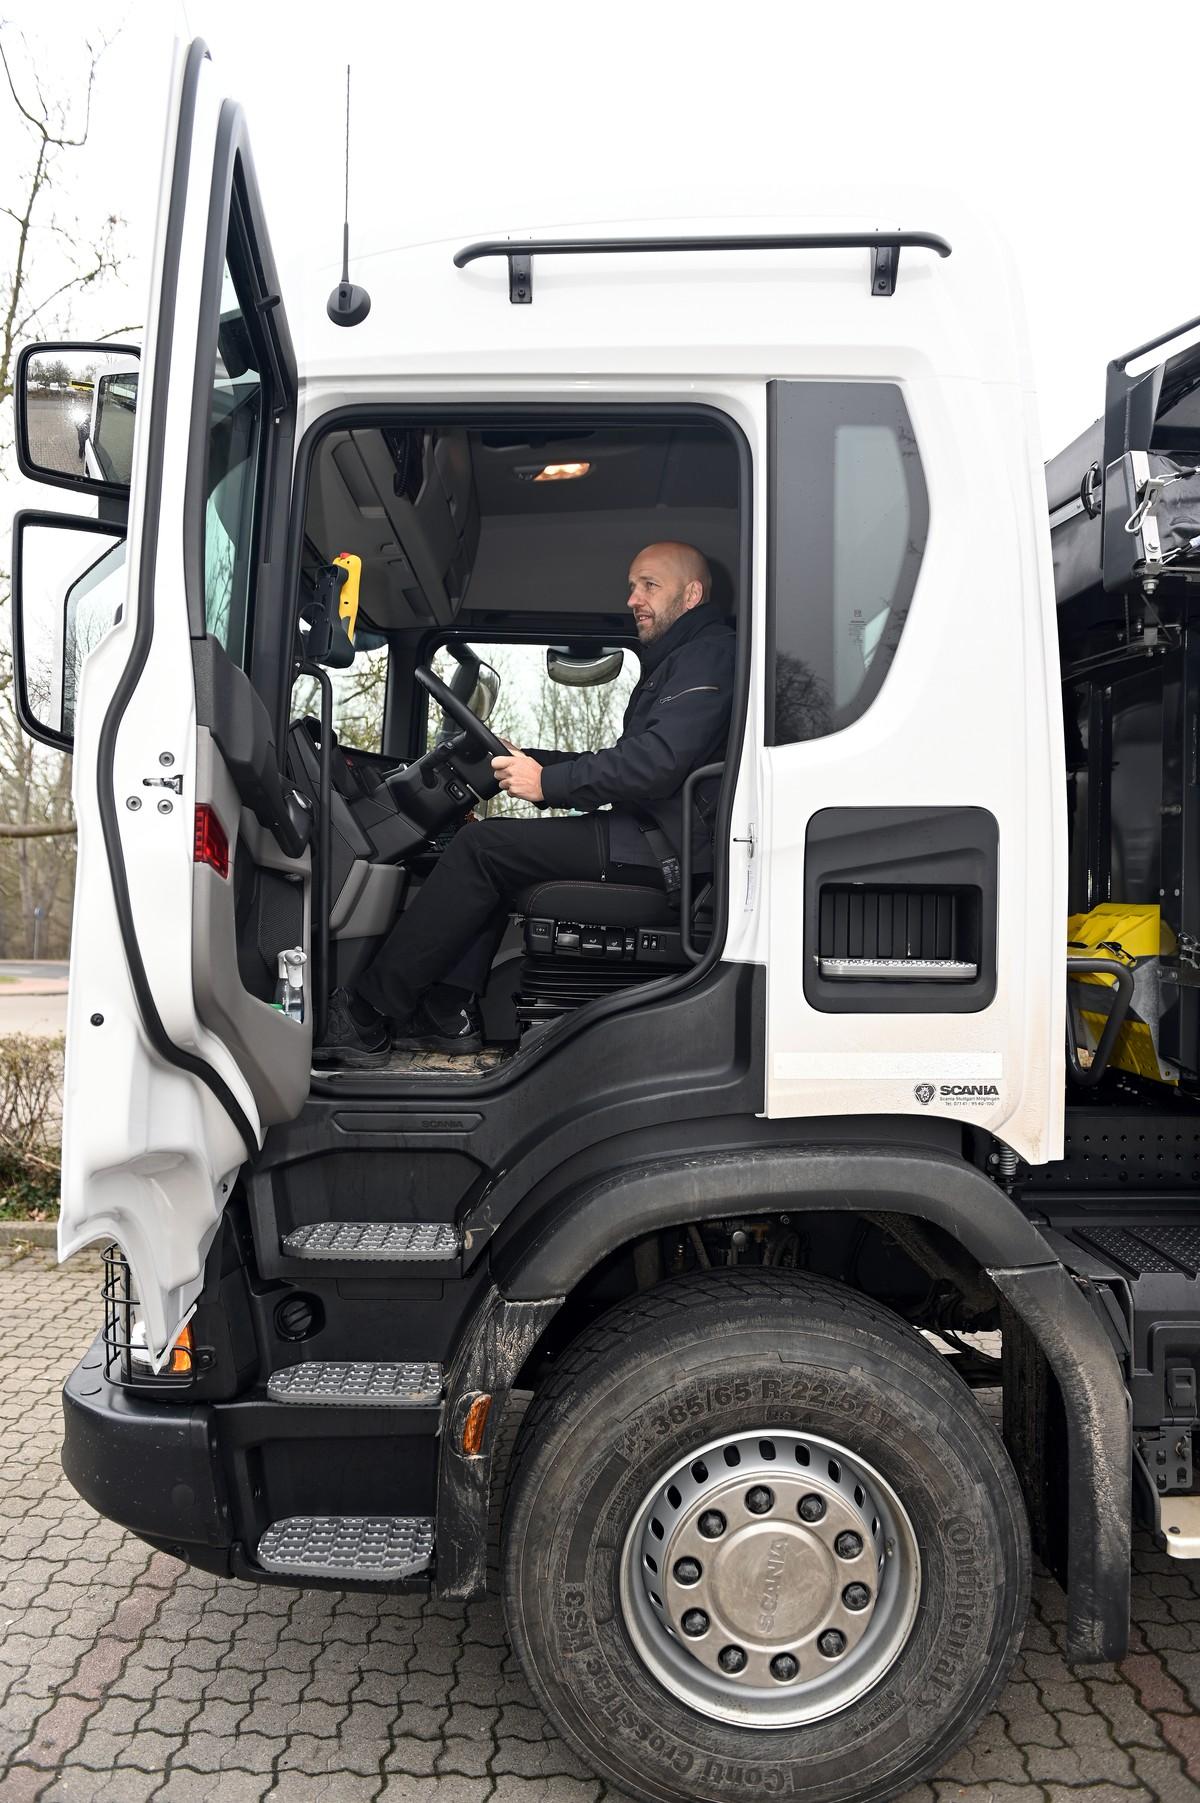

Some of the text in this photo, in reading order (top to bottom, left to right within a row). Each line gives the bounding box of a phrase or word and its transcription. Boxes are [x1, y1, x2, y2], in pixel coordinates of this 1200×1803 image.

[940, 1085, 999, 1096] SCANIA
[651, 1379, 857, 1435] 385/65 R 22.5
[759, 1537, 789, 1634] SCANIA
[928, 1515, 982, 1692] Continental
[560, 1590, 785, 1791] Conti CrossTrac HS3
